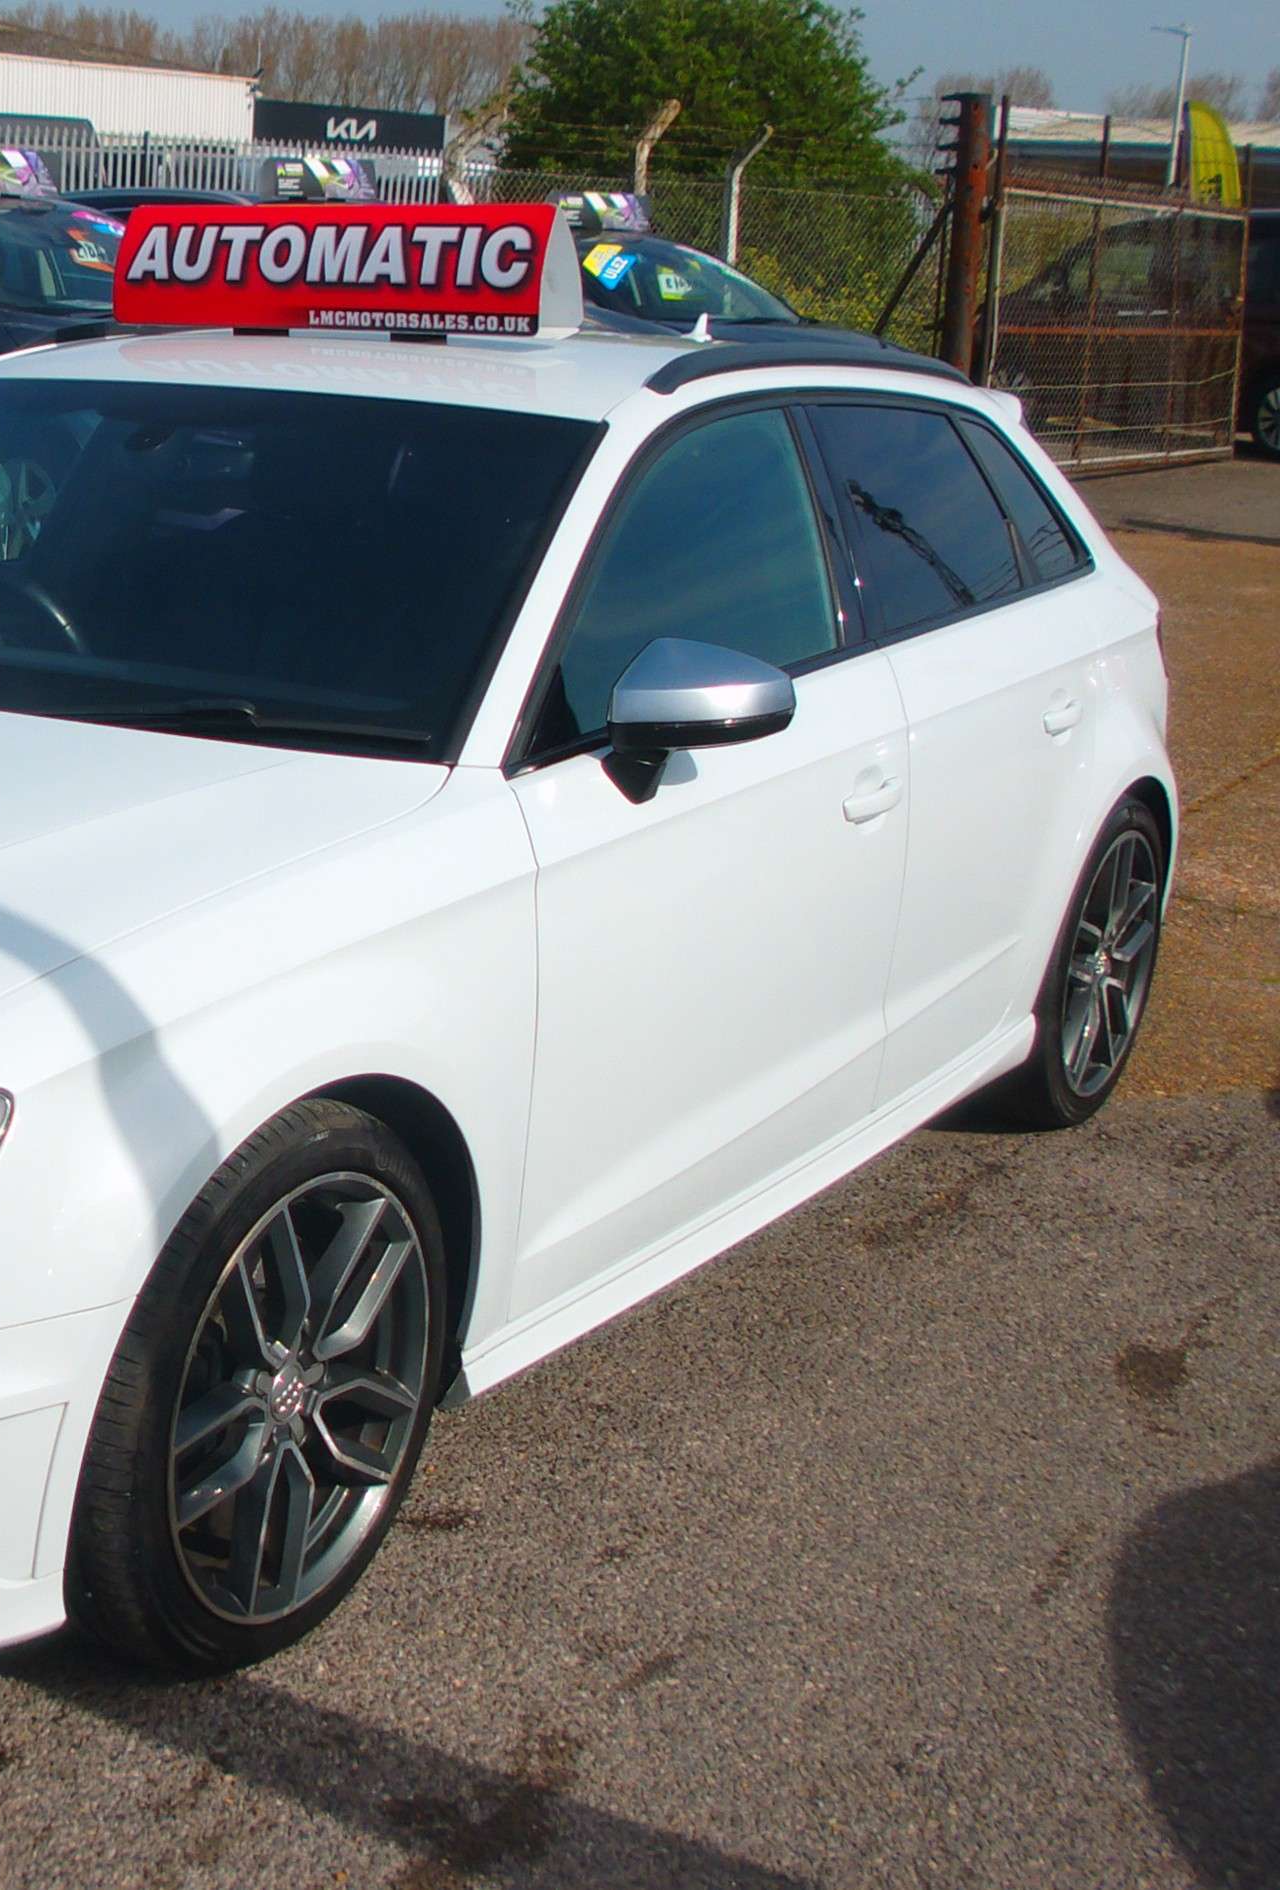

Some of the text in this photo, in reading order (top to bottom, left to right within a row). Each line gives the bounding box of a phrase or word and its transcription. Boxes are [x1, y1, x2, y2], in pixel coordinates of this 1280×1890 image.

[326, 116, 377, 141] KIA
[125, 224, 533, 289] AUTOMATIC
[308, 310, 531, 332] LMCMOTORSALES.CO.UK
